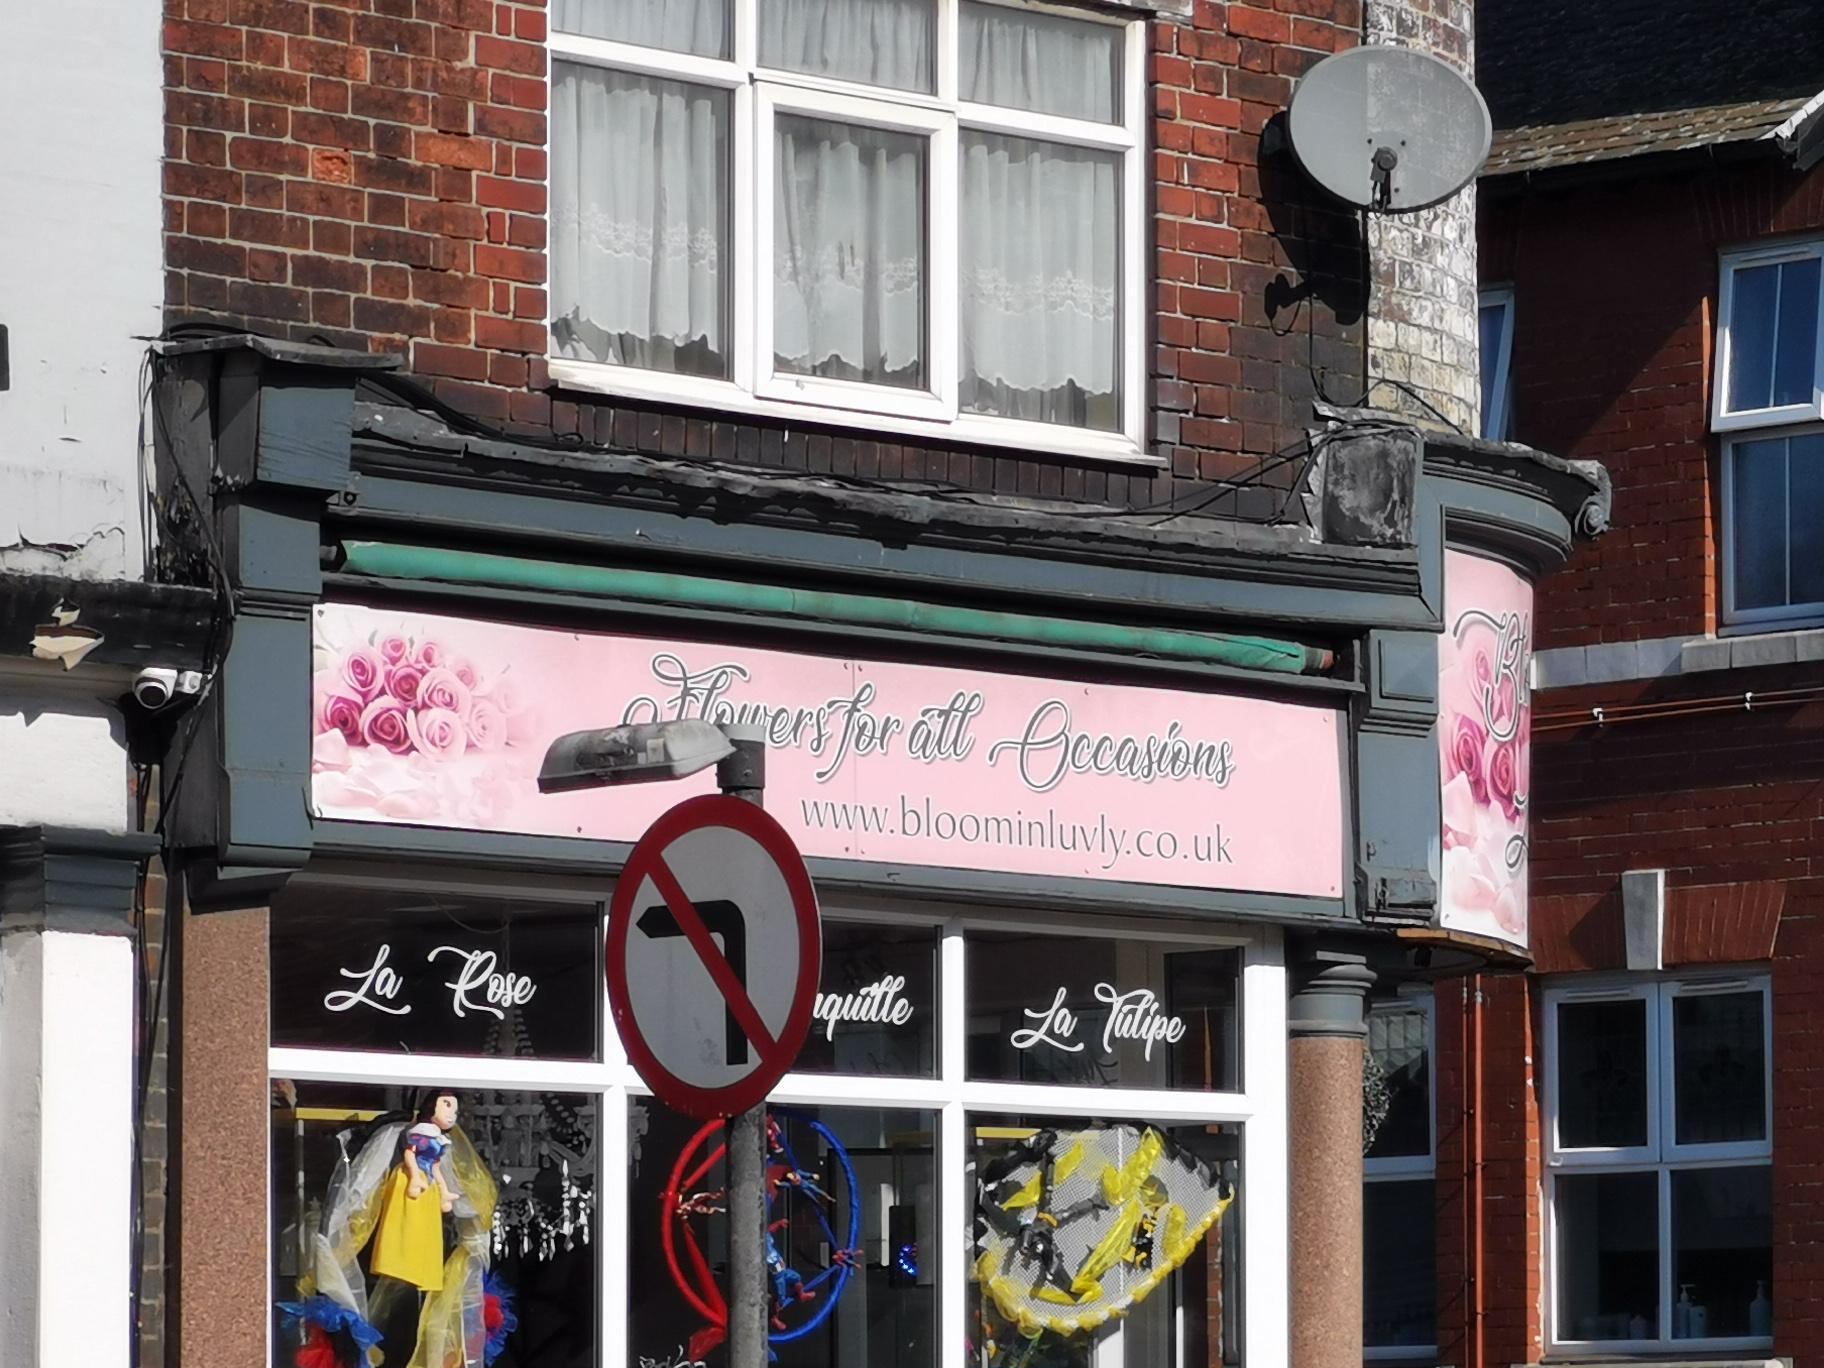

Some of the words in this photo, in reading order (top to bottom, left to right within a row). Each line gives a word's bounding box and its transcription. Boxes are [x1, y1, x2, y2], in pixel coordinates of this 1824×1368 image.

[816, 683, 901, 779] for
[907, 691, 982, 759] all
[988, 701, 1235, 788] Occasions
[801, 794, 1232, 869] www.bloominluvly.co.uk
[323, 943, 412, 1014] La
[427, 945, 537, 1020] Rose
[1010, 986, 1085, 1052] La
[1094, 982, 1186, 1062] Tulipe
